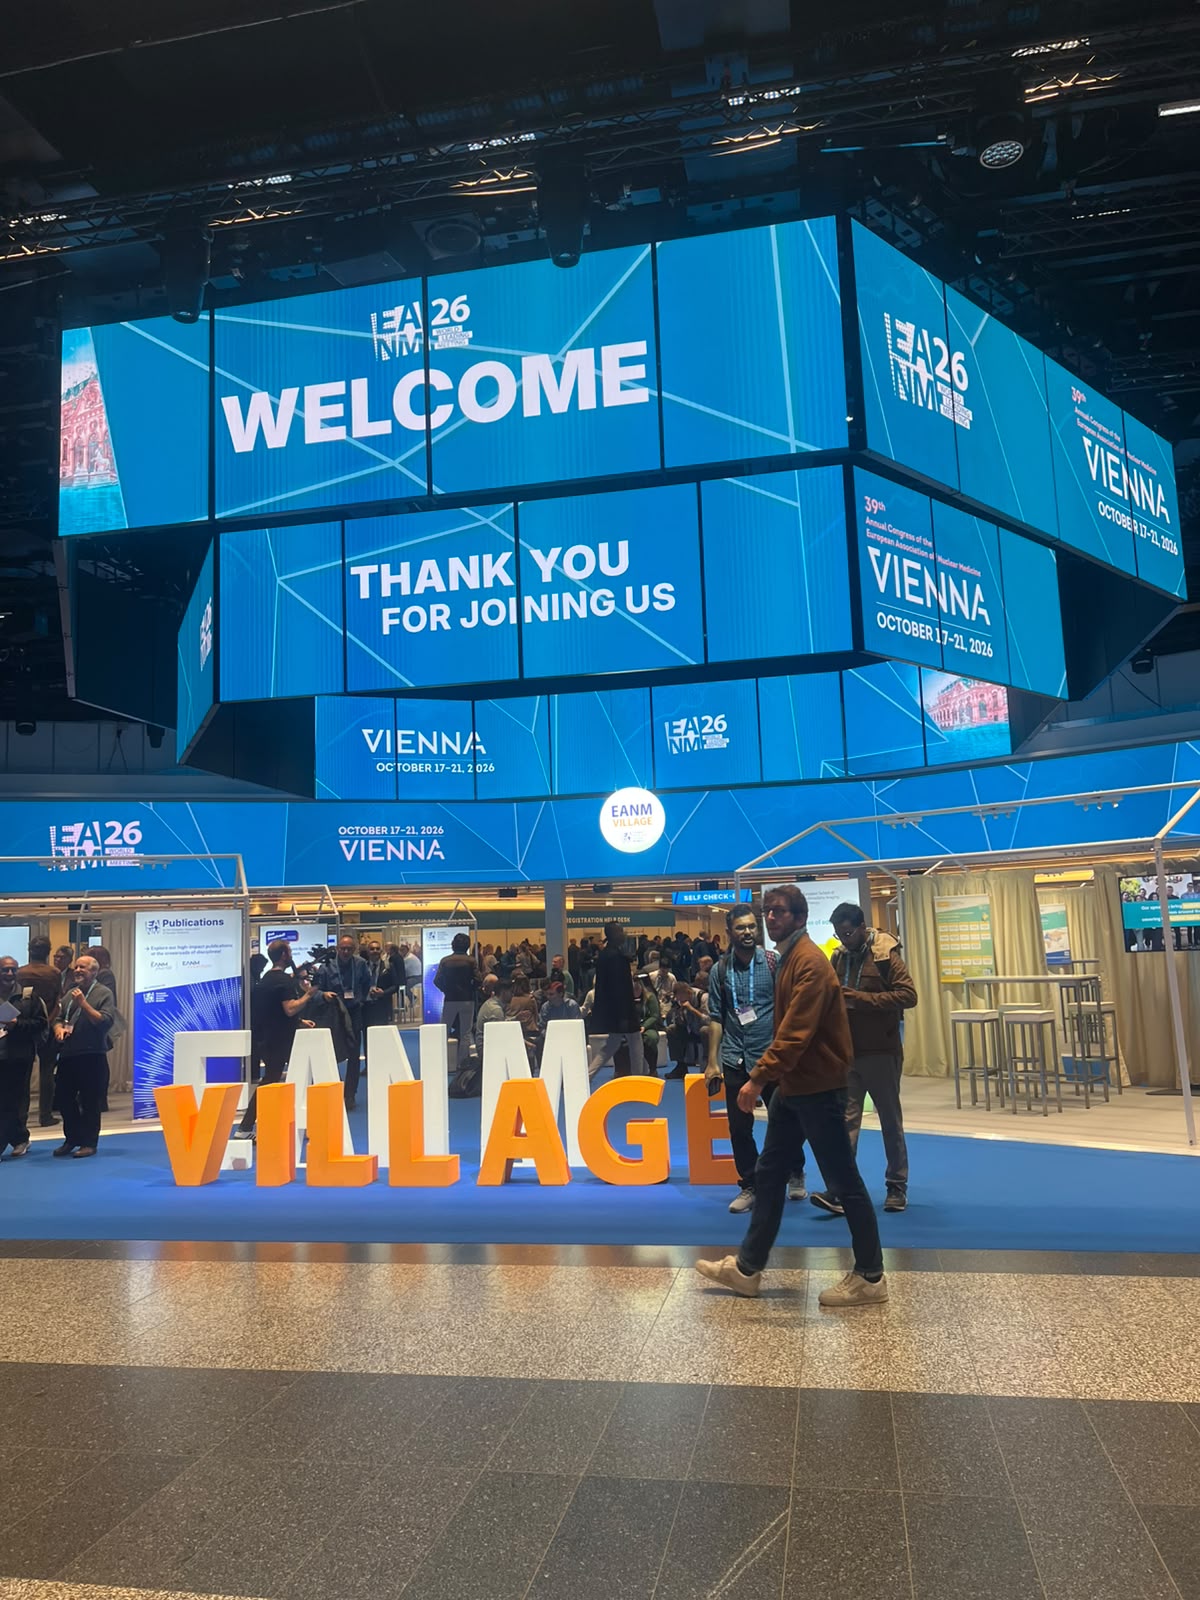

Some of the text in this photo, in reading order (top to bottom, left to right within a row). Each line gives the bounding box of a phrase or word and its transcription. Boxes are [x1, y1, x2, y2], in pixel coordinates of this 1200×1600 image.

[431, 294, 470, 326] 26
[933, 337, 968, 391] 26
[221, 341, 650, 453] WELCOME
[1082, 435, 1170, 524] VIENNA
[864, 496, 886, 515] 39th
[865, 516, 887, 531] Annual
[887, 524, 915, 541] Congress
[922, 537, 933, 548] the
[866, 528, 894, 546] European
[895, 540, 928, 558] Association
[1098, 501, 1138, 536] OCTOBER
[1161, 535, 1178, 556] 2026
[350, 540, 629, 599] THANK YOU
[867, 546, 991, 626] VIENNA
[382, 582, 676, 635] FOR JOINING US
[877, 612, 933, 642] OCTOBER
[969, 638, 993, 658] 2026
[701, 714, 728, 733] 26
[362, 729, 487, 755] VIENNA
[376, 762, 432, 773] OCTOBER
[467, 763, 495, 773] 2026
[611, 803, 652, 818] EANM
[613, 816, 653, 827] VILLAGE
[104, 820, 143, 845] 26
[338, 826, 388, 835] OCTOBER
[421, 826, 444, 835] 2026
[339, 839, 445, 861] VIENNA
[162, 918, 224, 927] Publications
[173, 1019, 590, 1170] EANM
[153, 1074, 740, 1187] VILLAGE
